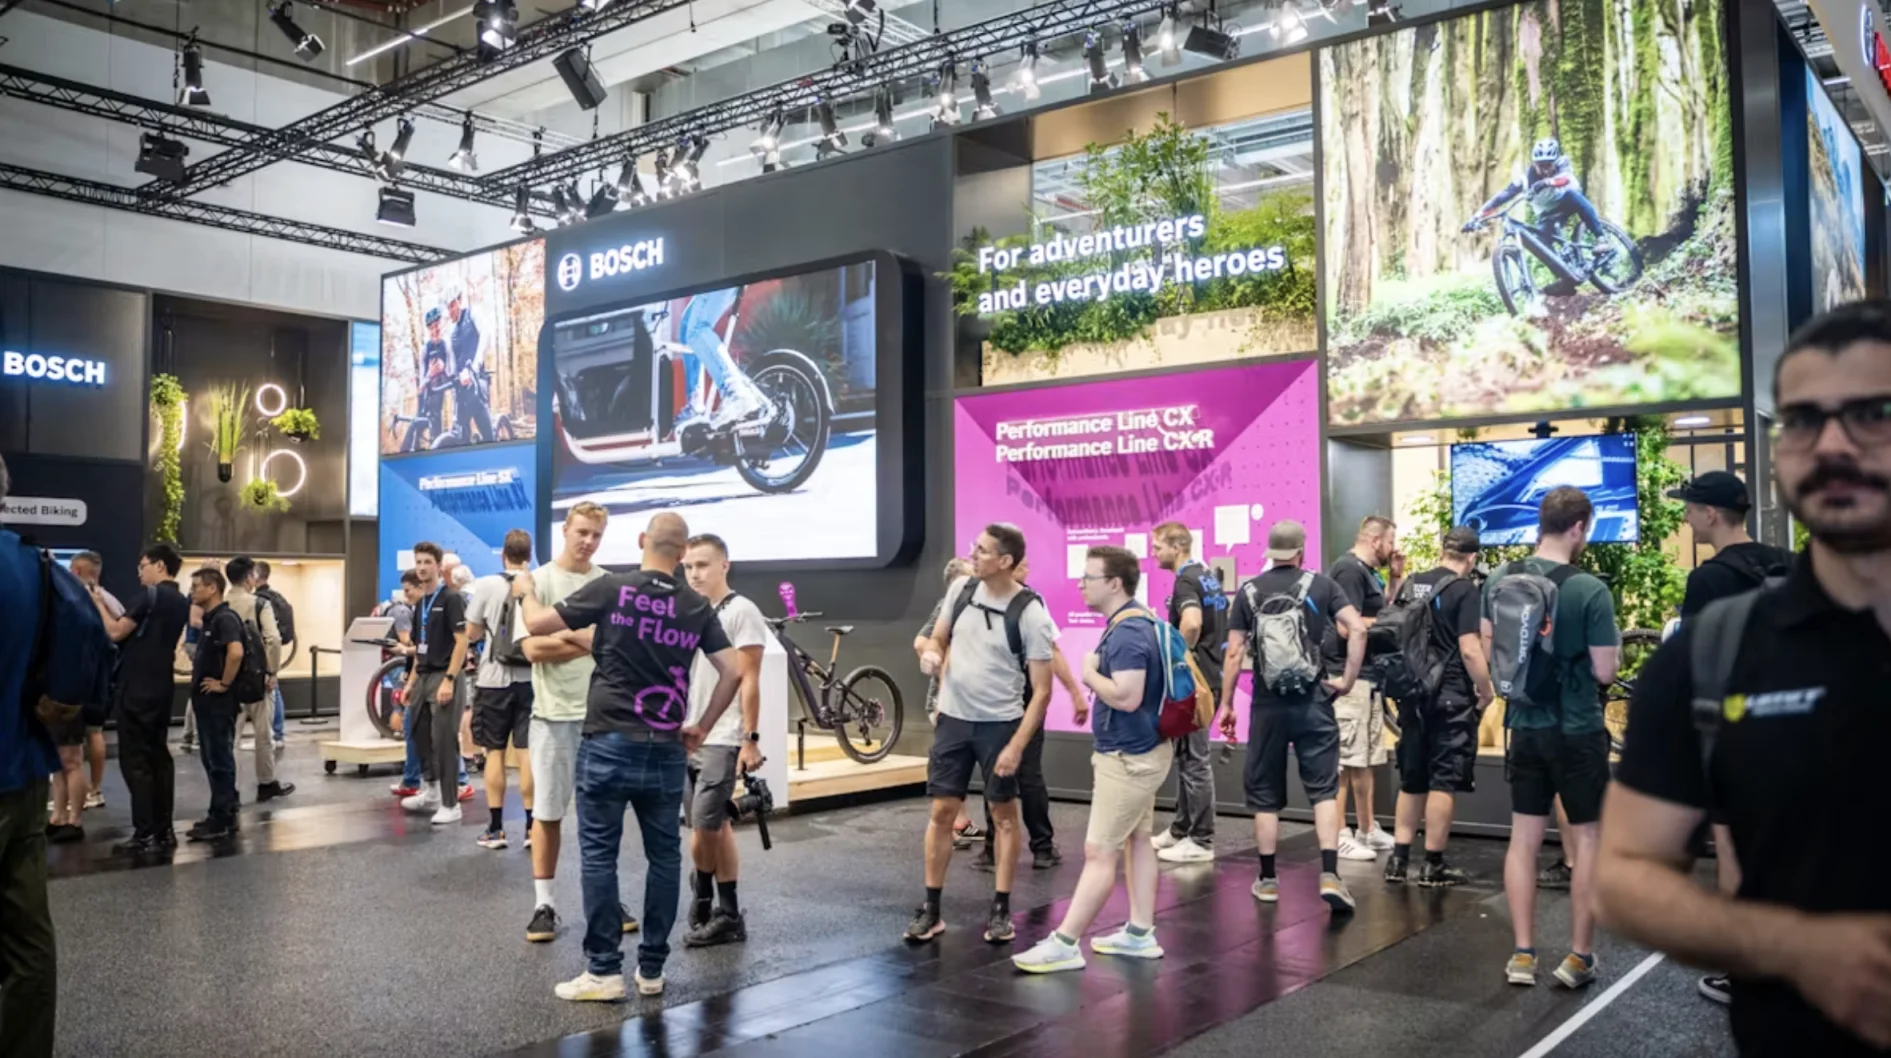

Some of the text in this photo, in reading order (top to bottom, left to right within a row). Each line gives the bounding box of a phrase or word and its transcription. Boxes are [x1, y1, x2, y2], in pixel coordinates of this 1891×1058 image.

[589, 237, 664, 280] BOSCH
[979, 214, 1205, 273] For adventurers
[978, 245, 1286, 313] and everyday heroes
[3, 350, 106, 385] BOSCH
[996, 405, 1196, 441] Performance Line CX
[996, 441, 1112, 464] Performance
[1117, 433, 1159, 454] Line
[1, 504, 78, 518] ected Biking
[618, 584, 677, 619] Feel
[610, 612, 702, 650] the Flow
[1518, 603, 1533, 664] ORTOVOX
